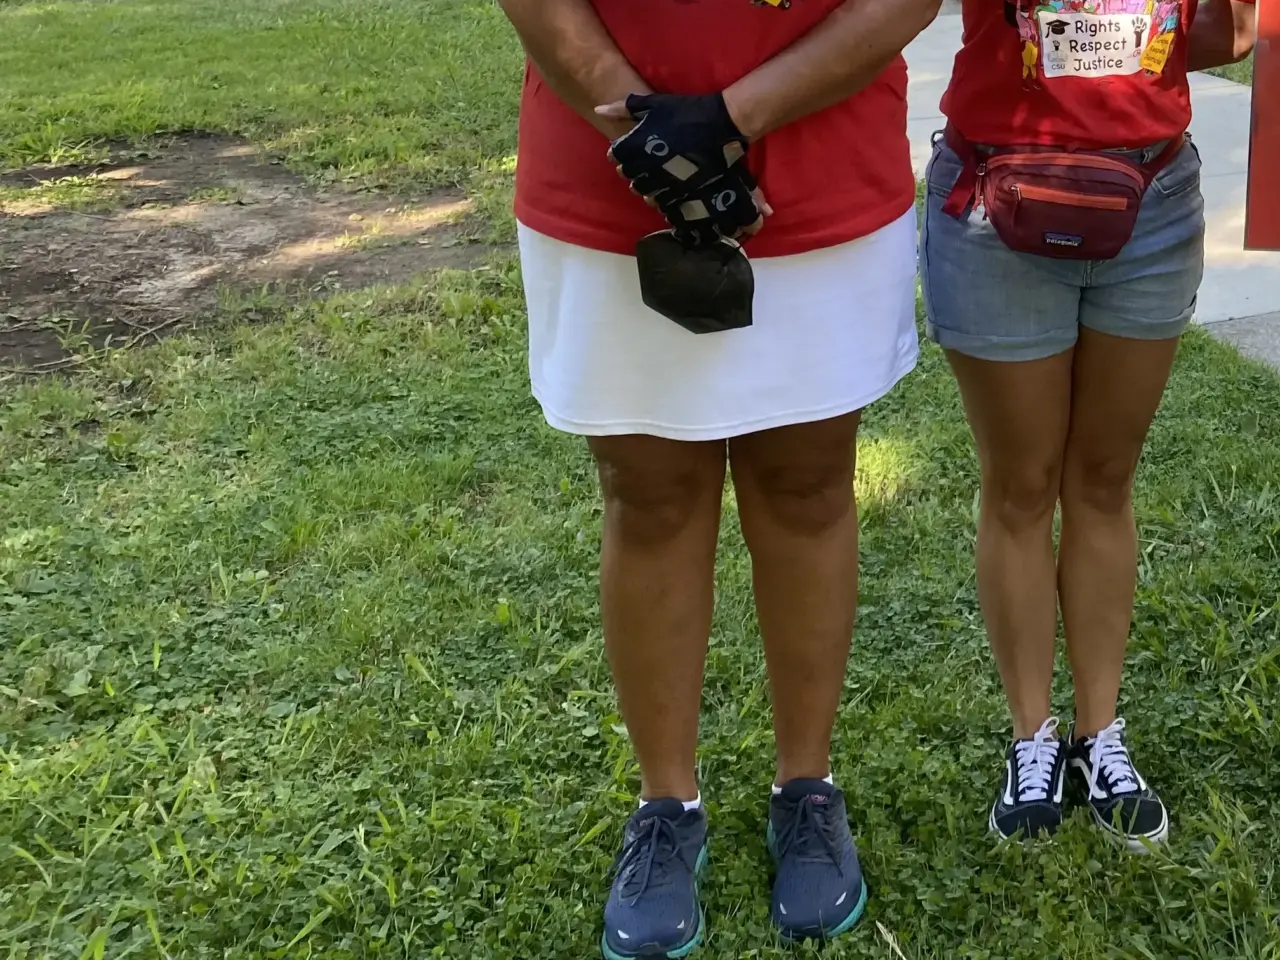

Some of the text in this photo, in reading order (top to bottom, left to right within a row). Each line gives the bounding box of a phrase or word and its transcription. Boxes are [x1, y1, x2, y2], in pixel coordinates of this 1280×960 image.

[1075, 19, 1121, 37] Rights
[1069, 37, 1128, 54] Respect
[1051, 63, 1066, 71] CSU
[1073, 56, 1124, 72] Justice
